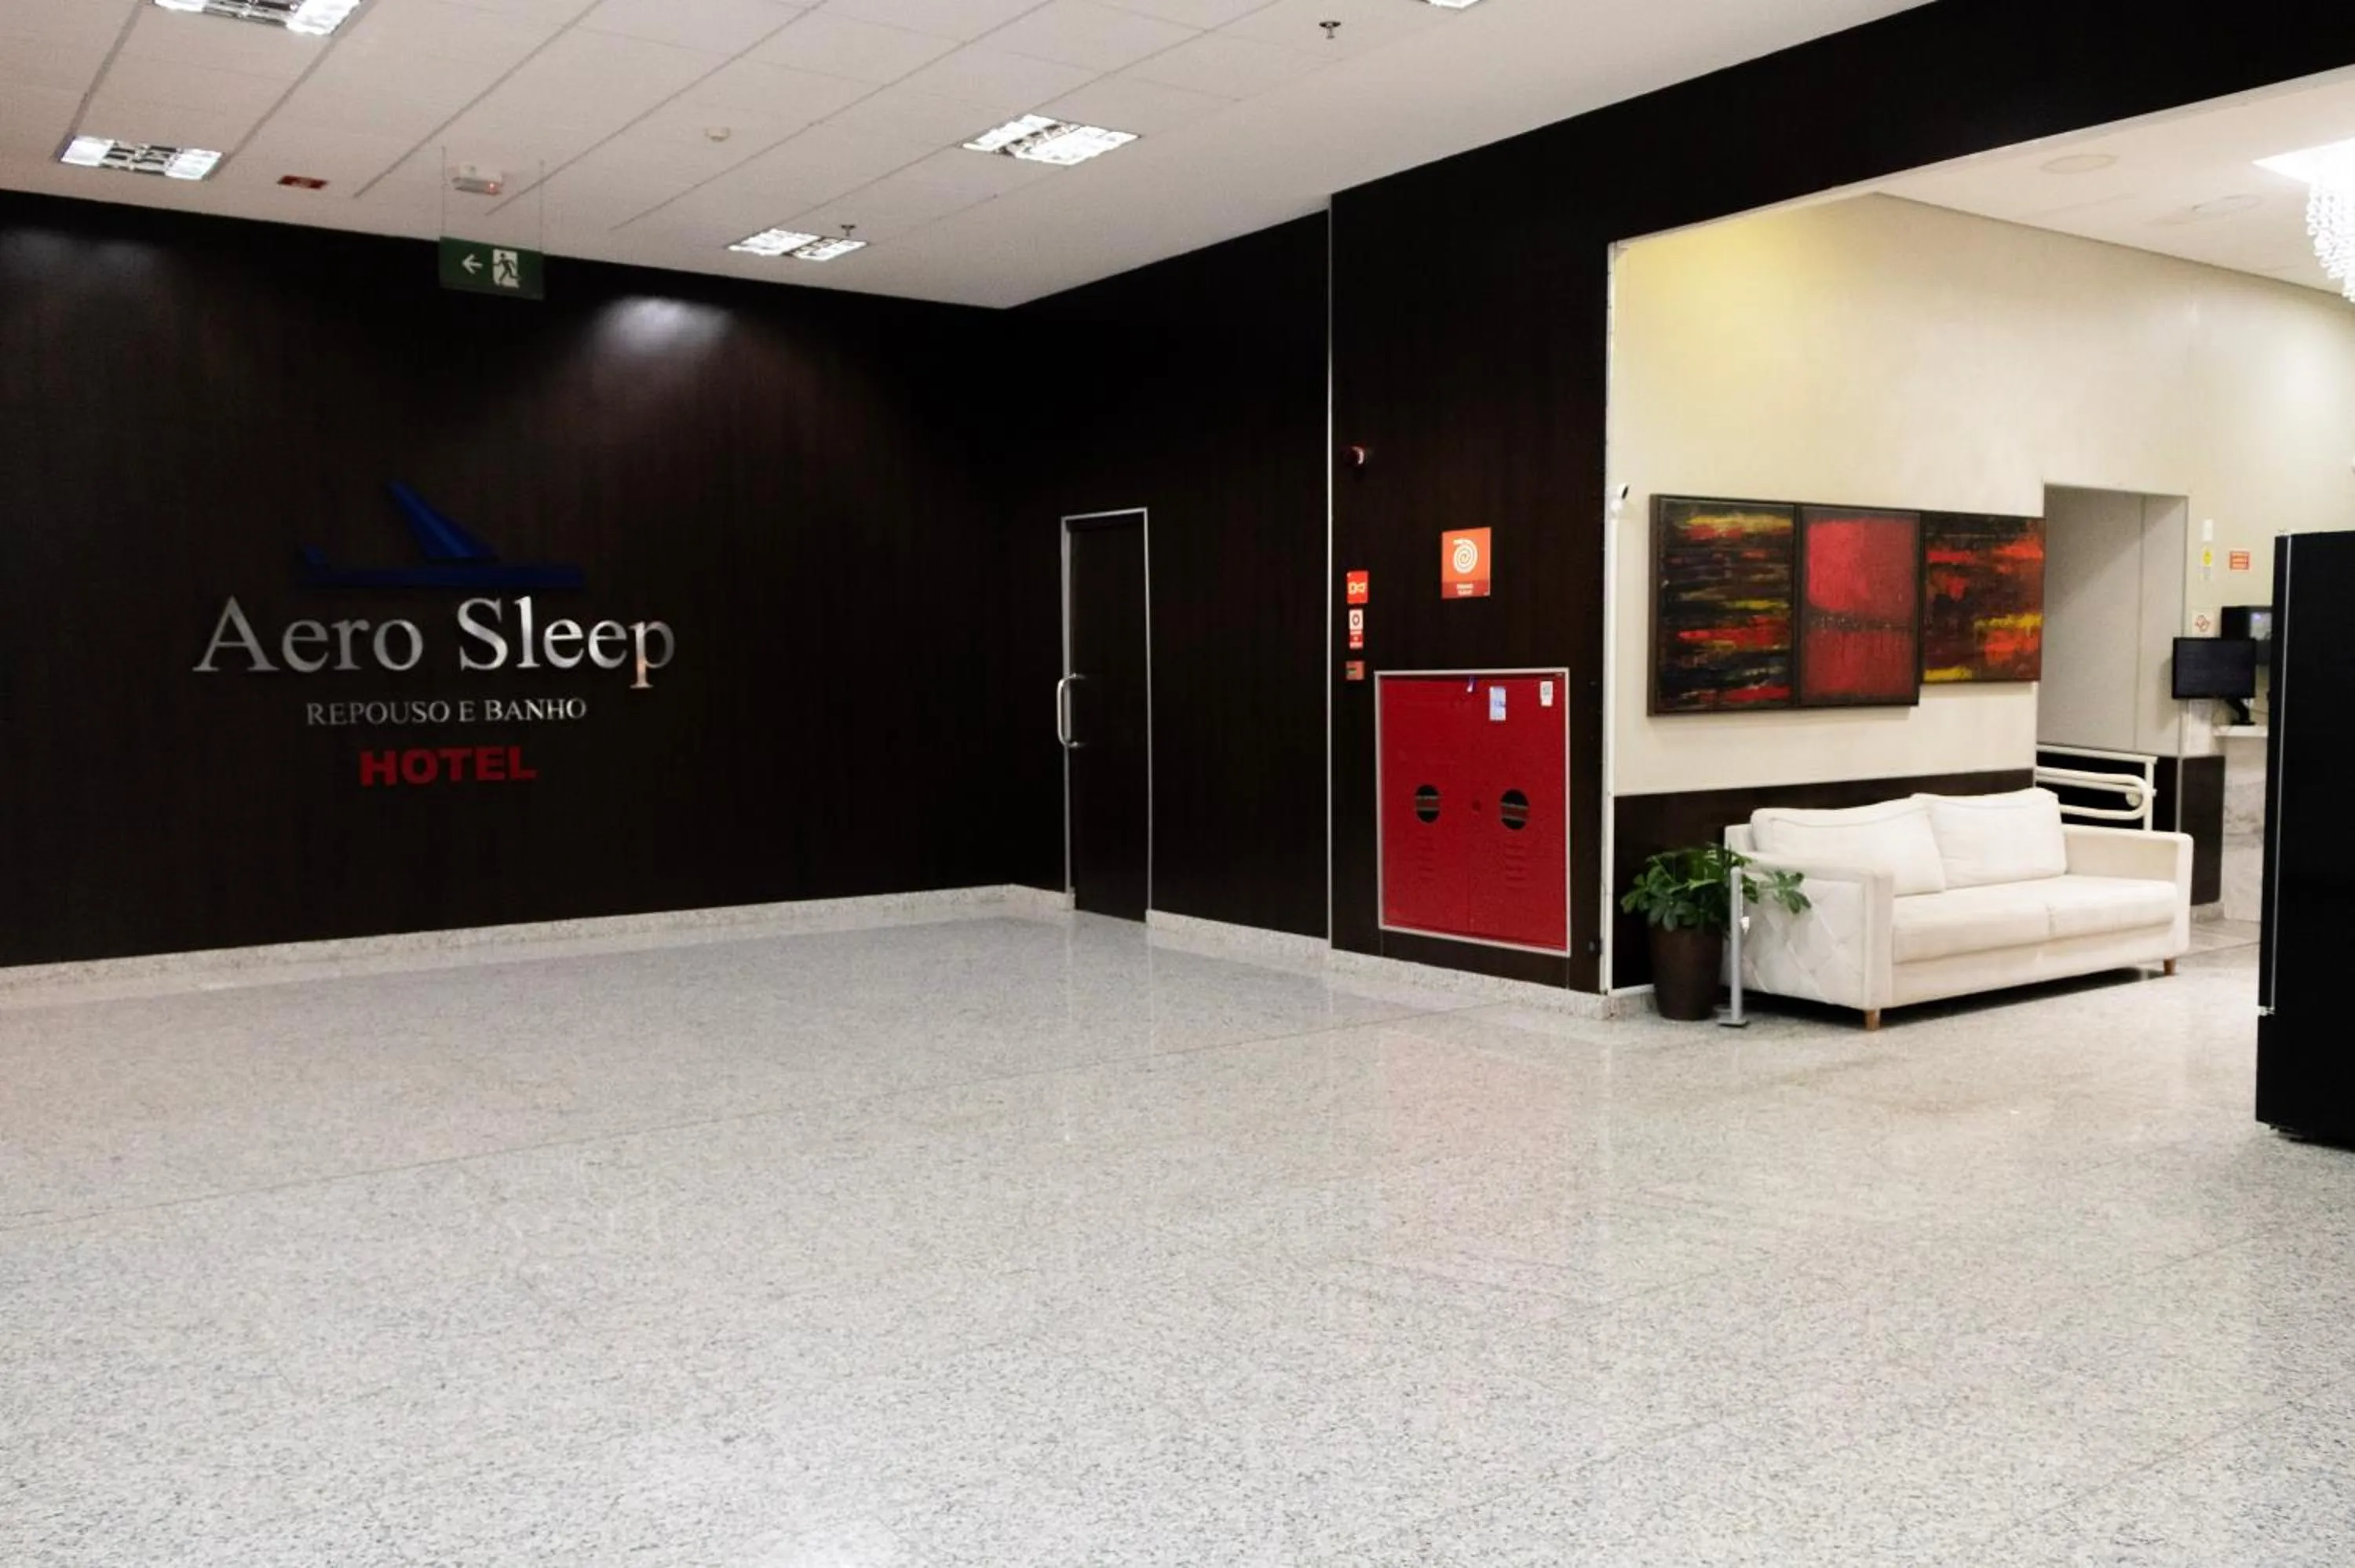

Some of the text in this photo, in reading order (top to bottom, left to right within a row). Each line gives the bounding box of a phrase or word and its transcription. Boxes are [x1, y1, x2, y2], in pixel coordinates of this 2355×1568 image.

[193, 596, 675, 689] Aero Sleep
[306, 697, 587, 727] REPOUSO E BANHO
[359, 746, 538, 786] HOTEL
